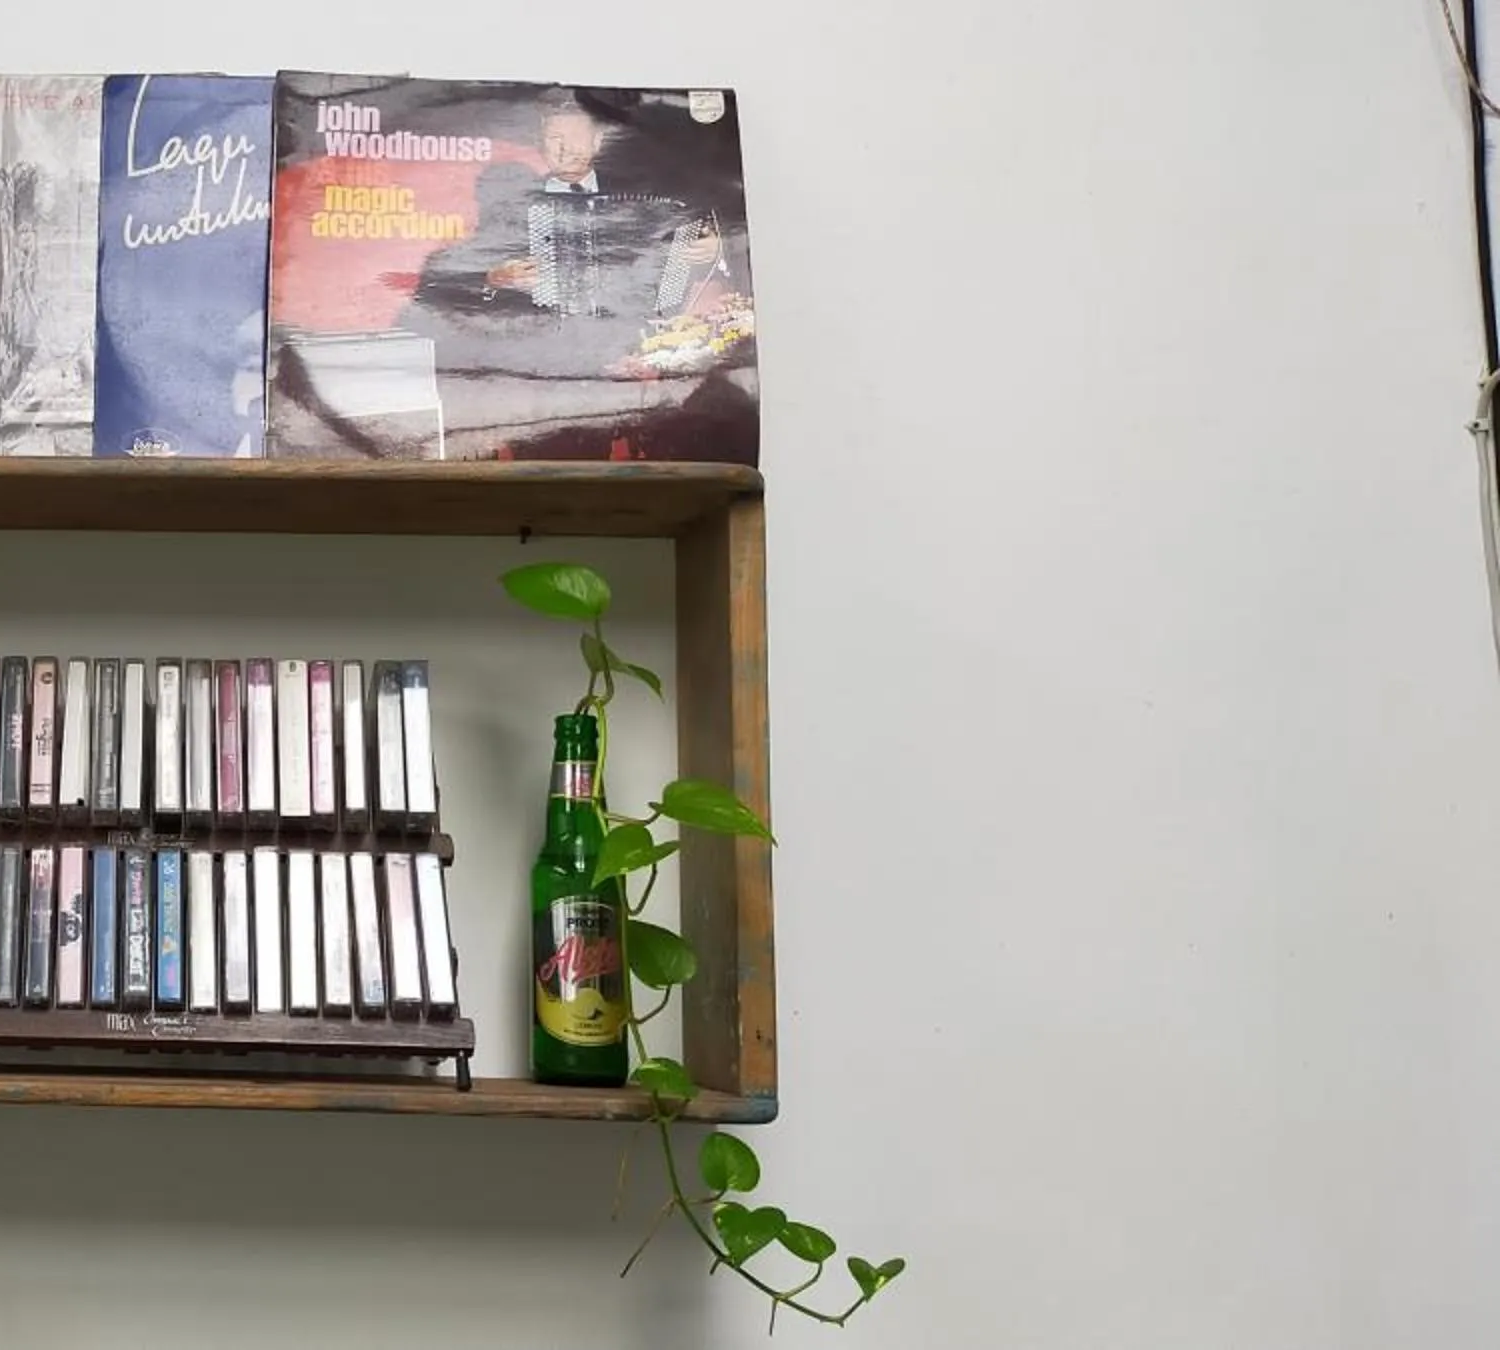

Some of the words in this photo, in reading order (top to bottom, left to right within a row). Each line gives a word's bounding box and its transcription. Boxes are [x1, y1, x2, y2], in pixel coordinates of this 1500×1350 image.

[316, 101, 381, 132] john
[325, 130, 492, 162] woodhouse
[323, 183, 415, 214] magic
[311, 210, 466, 240] accordion
